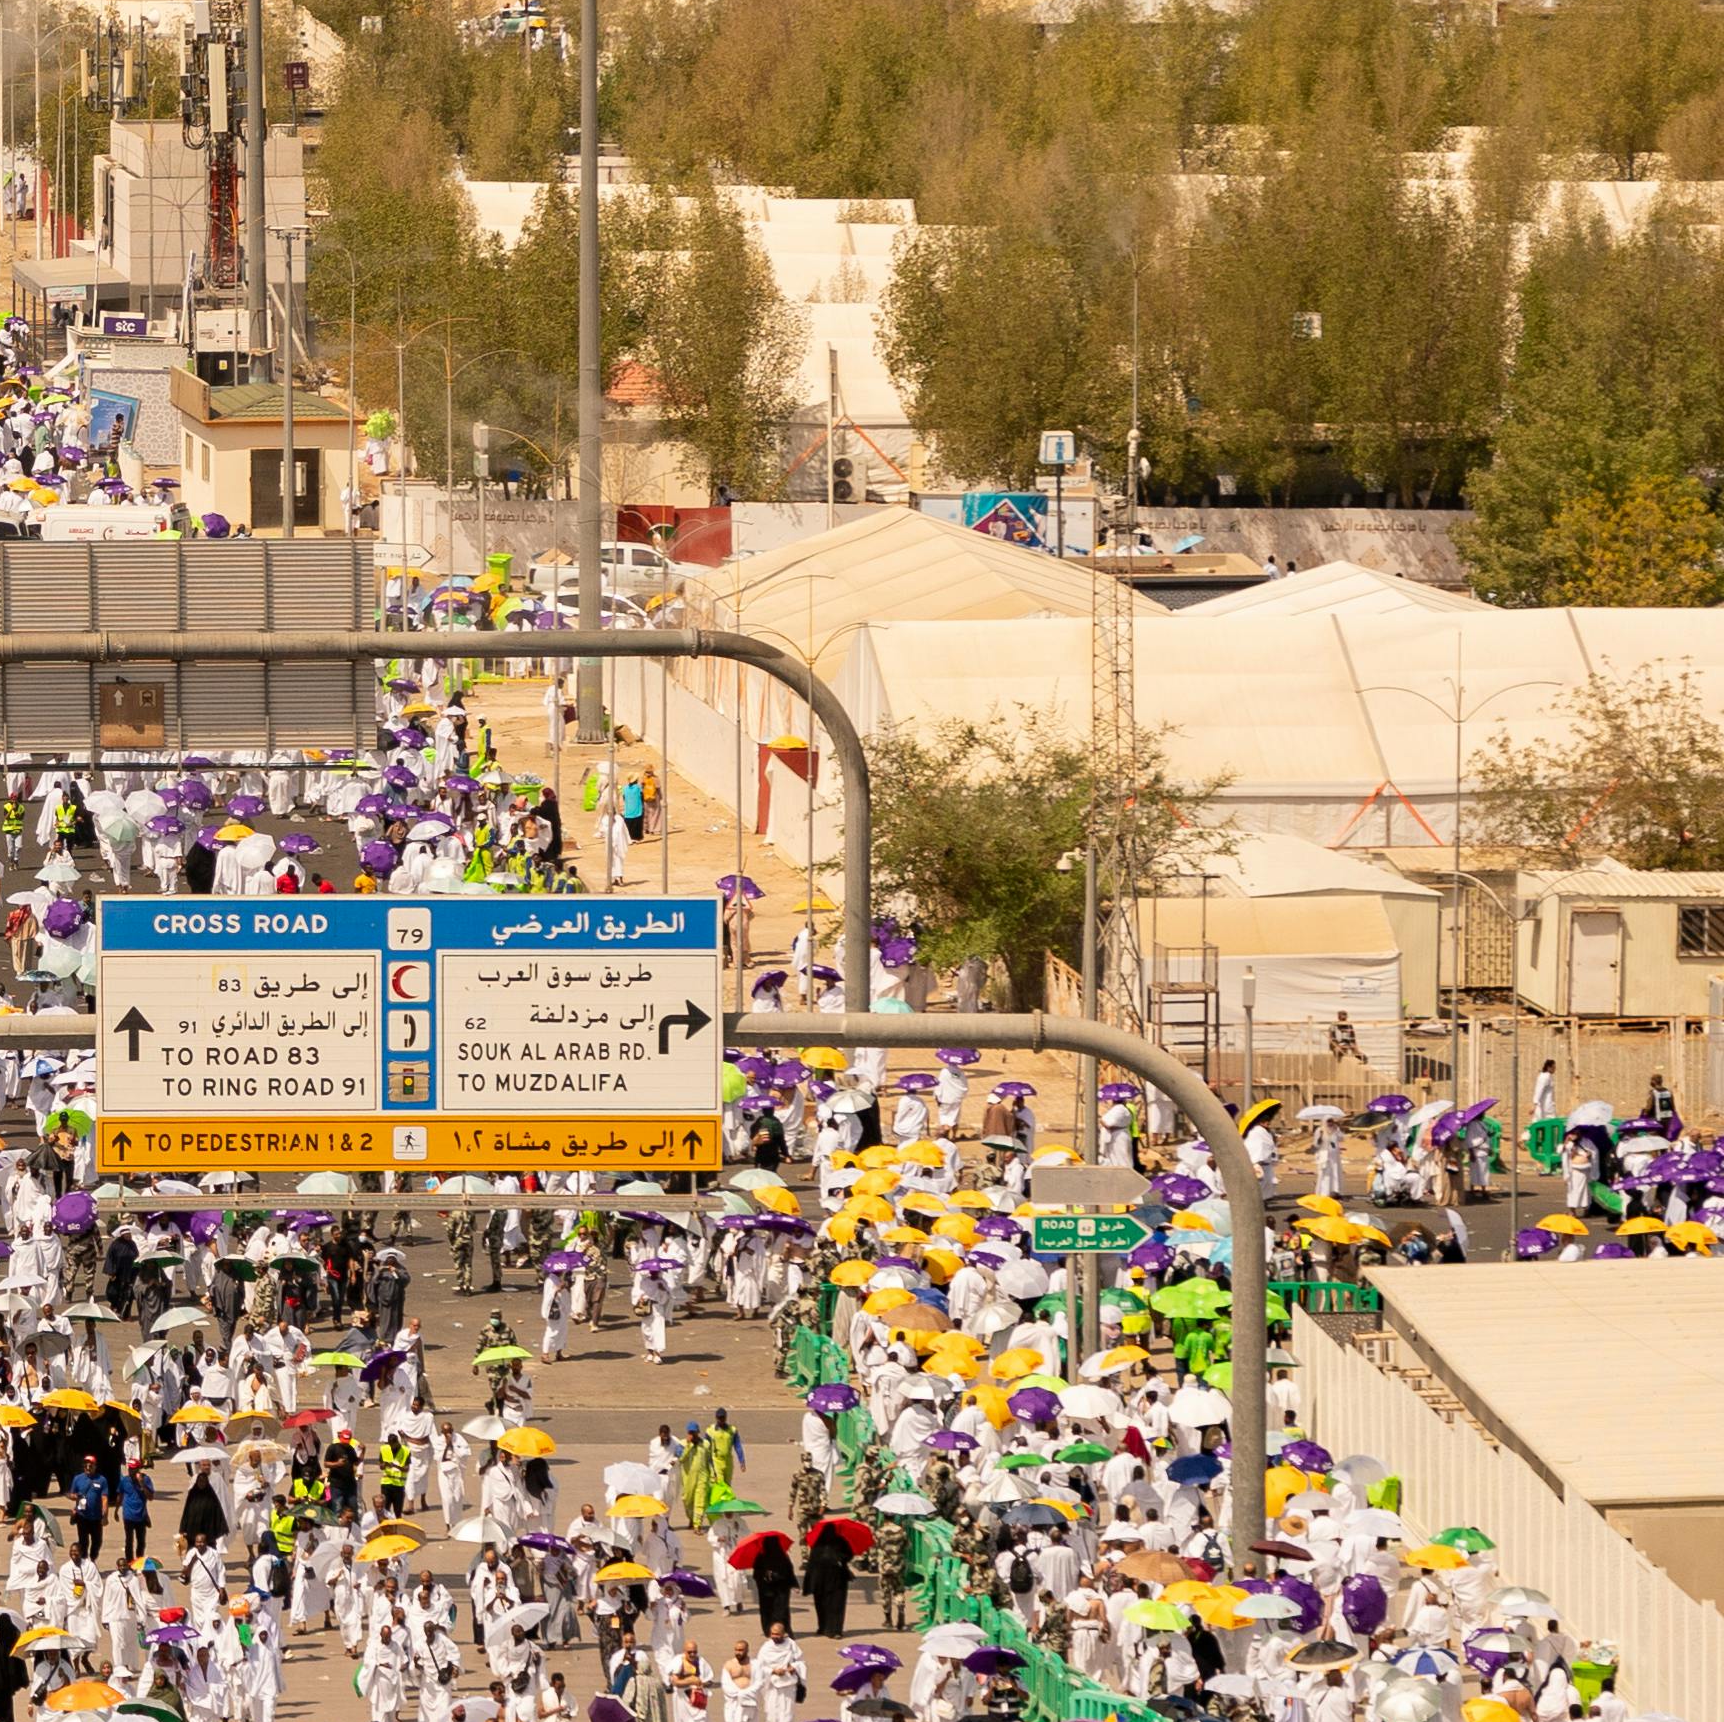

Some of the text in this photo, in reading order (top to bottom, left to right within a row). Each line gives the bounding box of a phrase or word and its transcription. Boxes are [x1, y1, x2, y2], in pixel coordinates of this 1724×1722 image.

[115, 320, 136, 333] stc
[153, 914, 328, 934] CROSS ROAD
[491, 911, 685, 945] الطريق العرضي
[396, 928, 424, 945] 79
[218, 972, 368, 999] إلى طريق 83
[478, 963, 653, 989] طريق سوق العرب
[179, 1010, 368, 1038] إلى الطريق الدائري 91
[465, 1003, 654, 1031] إلى مزدلفة 62
[162, 1047, 319, 1065] TO ROAD 83
[458, 1043, 651, 1061] SOUK AL ARAB RD.
[163, 1078, 365, 1096] TO RING ROAD 91
[458, 1074, 628, 1092] TO MUZDALIFA
[145, 1133, 374, 1152] TO PEDESTRIAN 1 & 2
[494, 1131, 551, 1151] مشاة
[561, 1131, 628, 1157] طريق
[639, 1131, 674, 1157] إلى
[1041, 1221, 1075, 1229] ROAD
[1098, 1222, 1125, 1232] طريق
[1076, 1239, 1097, 1248] سوق
